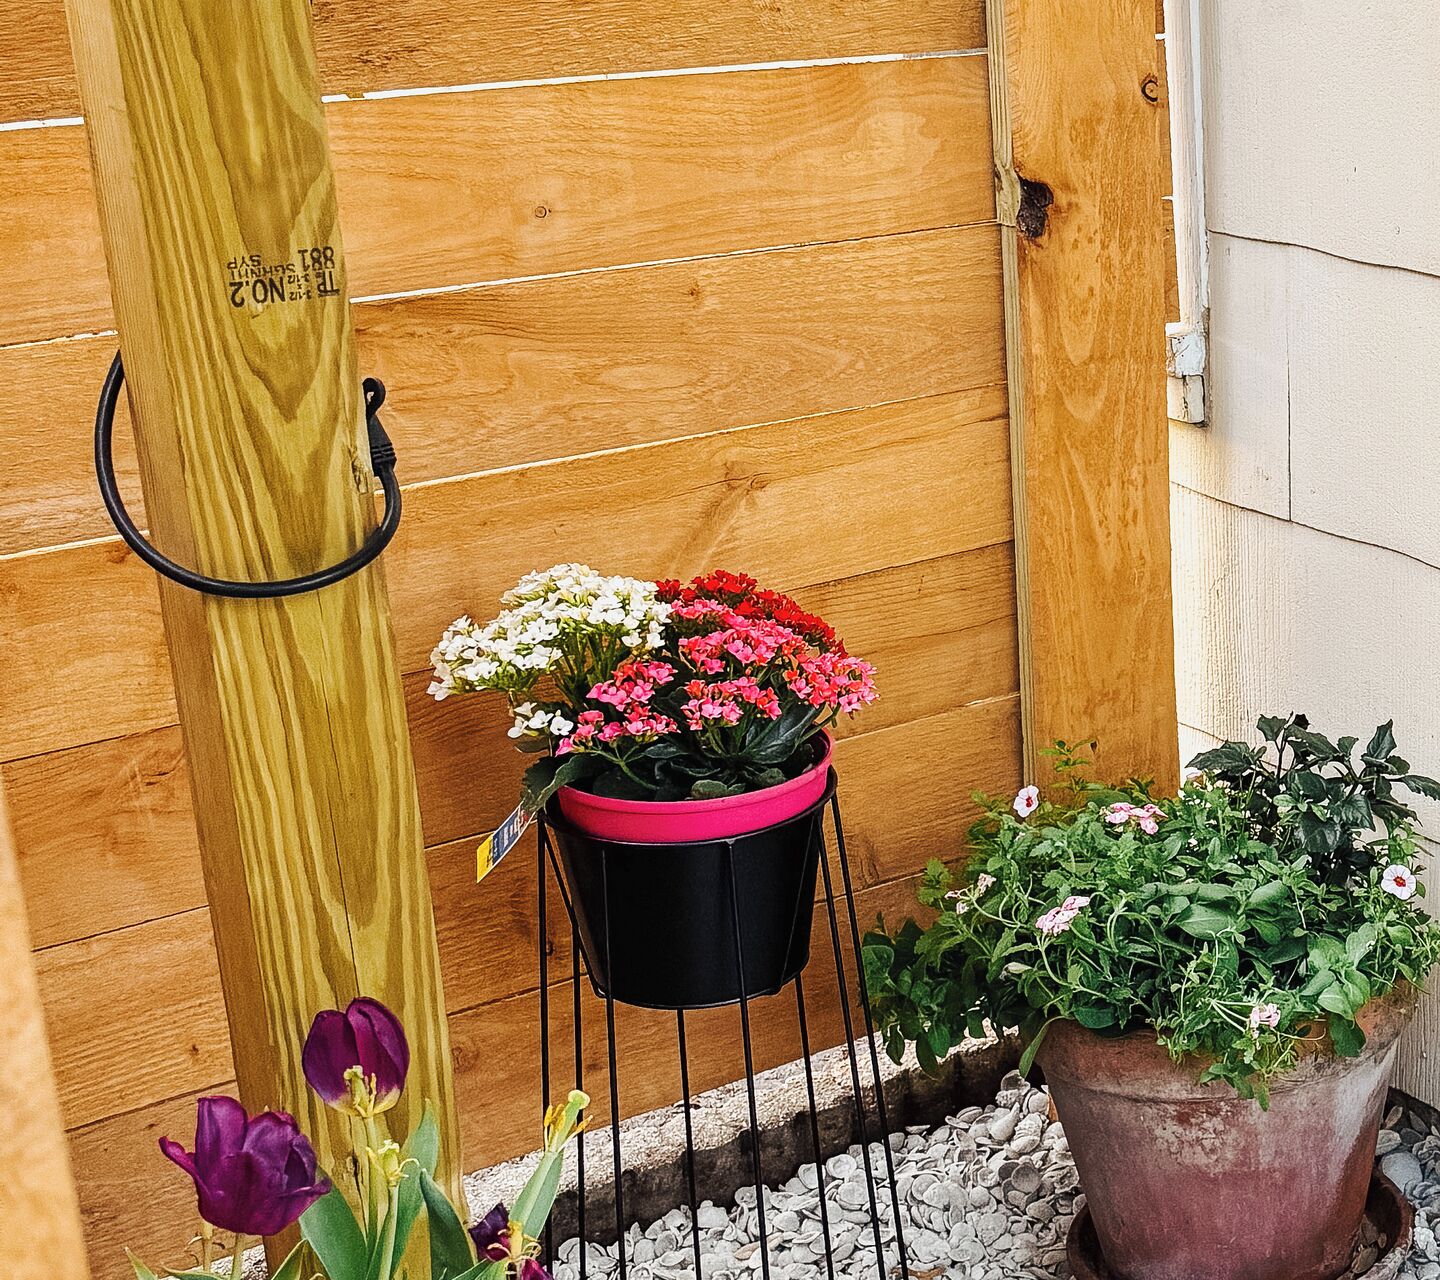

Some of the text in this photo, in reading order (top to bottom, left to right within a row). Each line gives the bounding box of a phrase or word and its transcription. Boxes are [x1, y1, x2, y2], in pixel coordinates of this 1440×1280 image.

[227, 254, 261, 270] SYP
[298, 246, 335, 272] 881
[229, 276, 286, 308] NO.2
